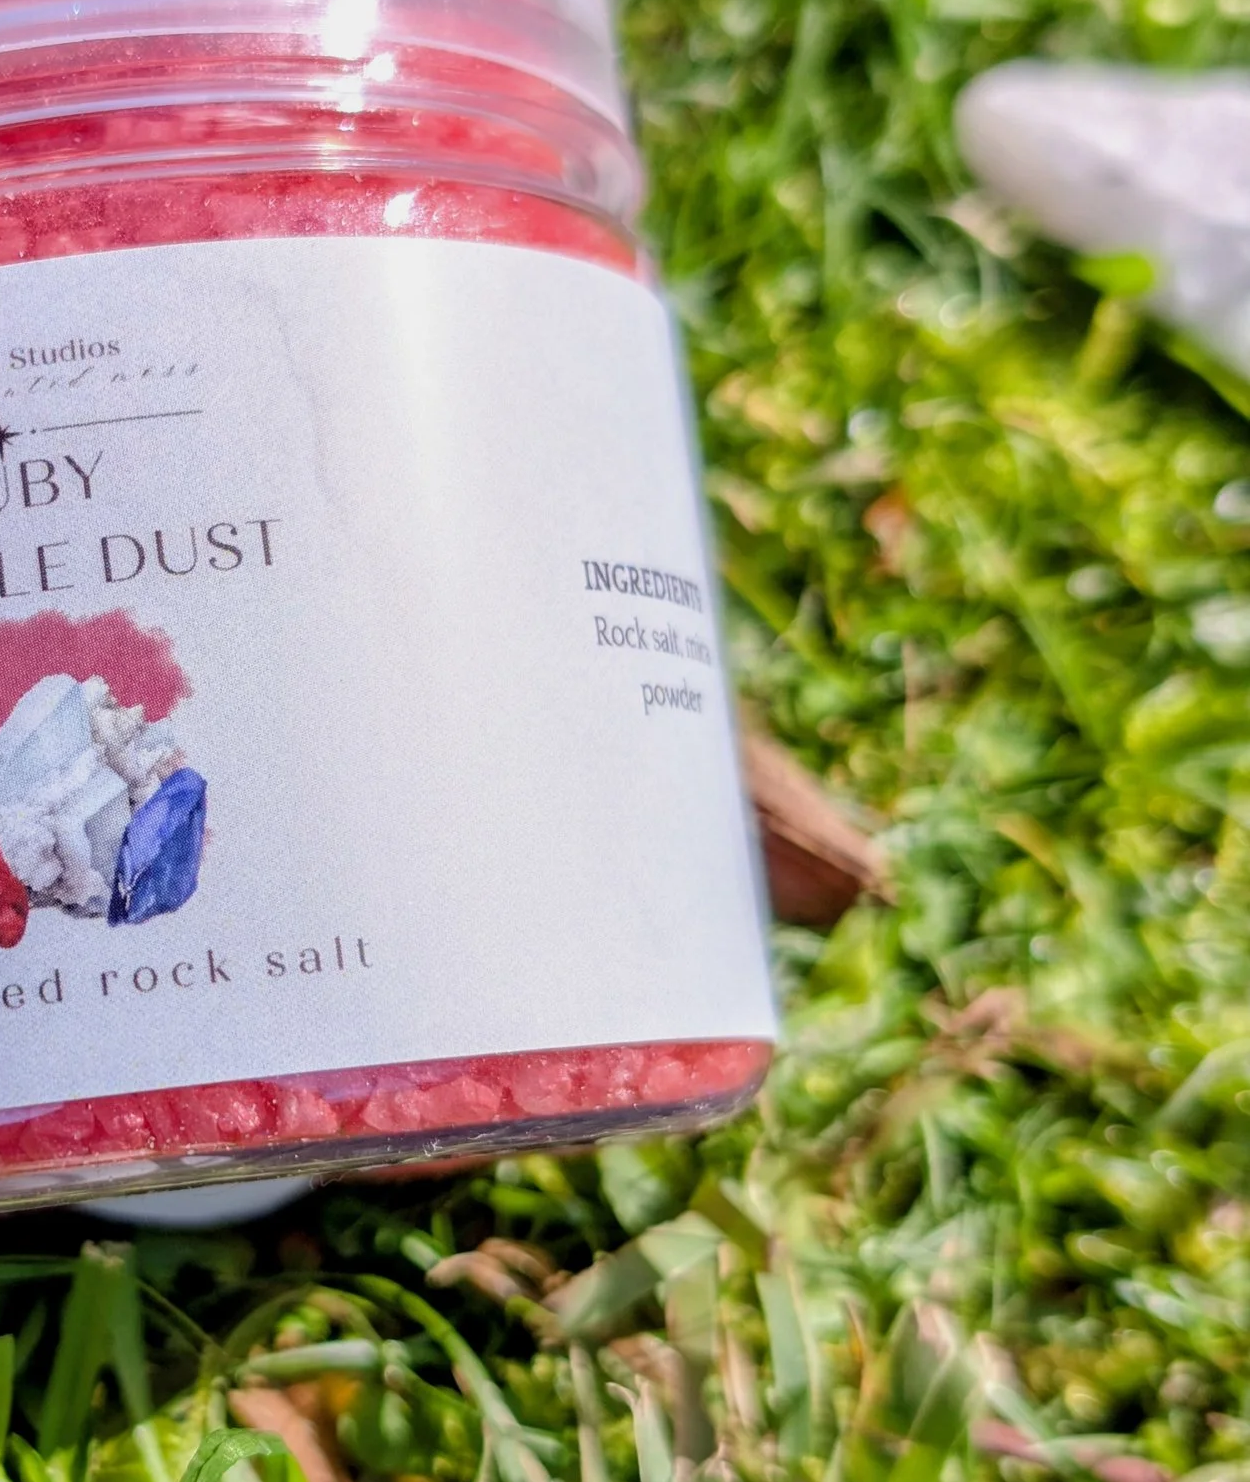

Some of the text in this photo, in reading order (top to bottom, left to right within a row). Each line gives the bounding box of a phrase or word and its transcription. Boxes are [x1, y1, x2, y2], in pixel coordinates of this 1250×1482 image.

[10, 338, 122, 370] Studios
[100, 518, 282, 585] DUST
[594, 615, 649, 651] Rock
[641, 677, 703, 716] powder
[101, 949, 231, 996] rock
[266, 937, 375, 979] salt
